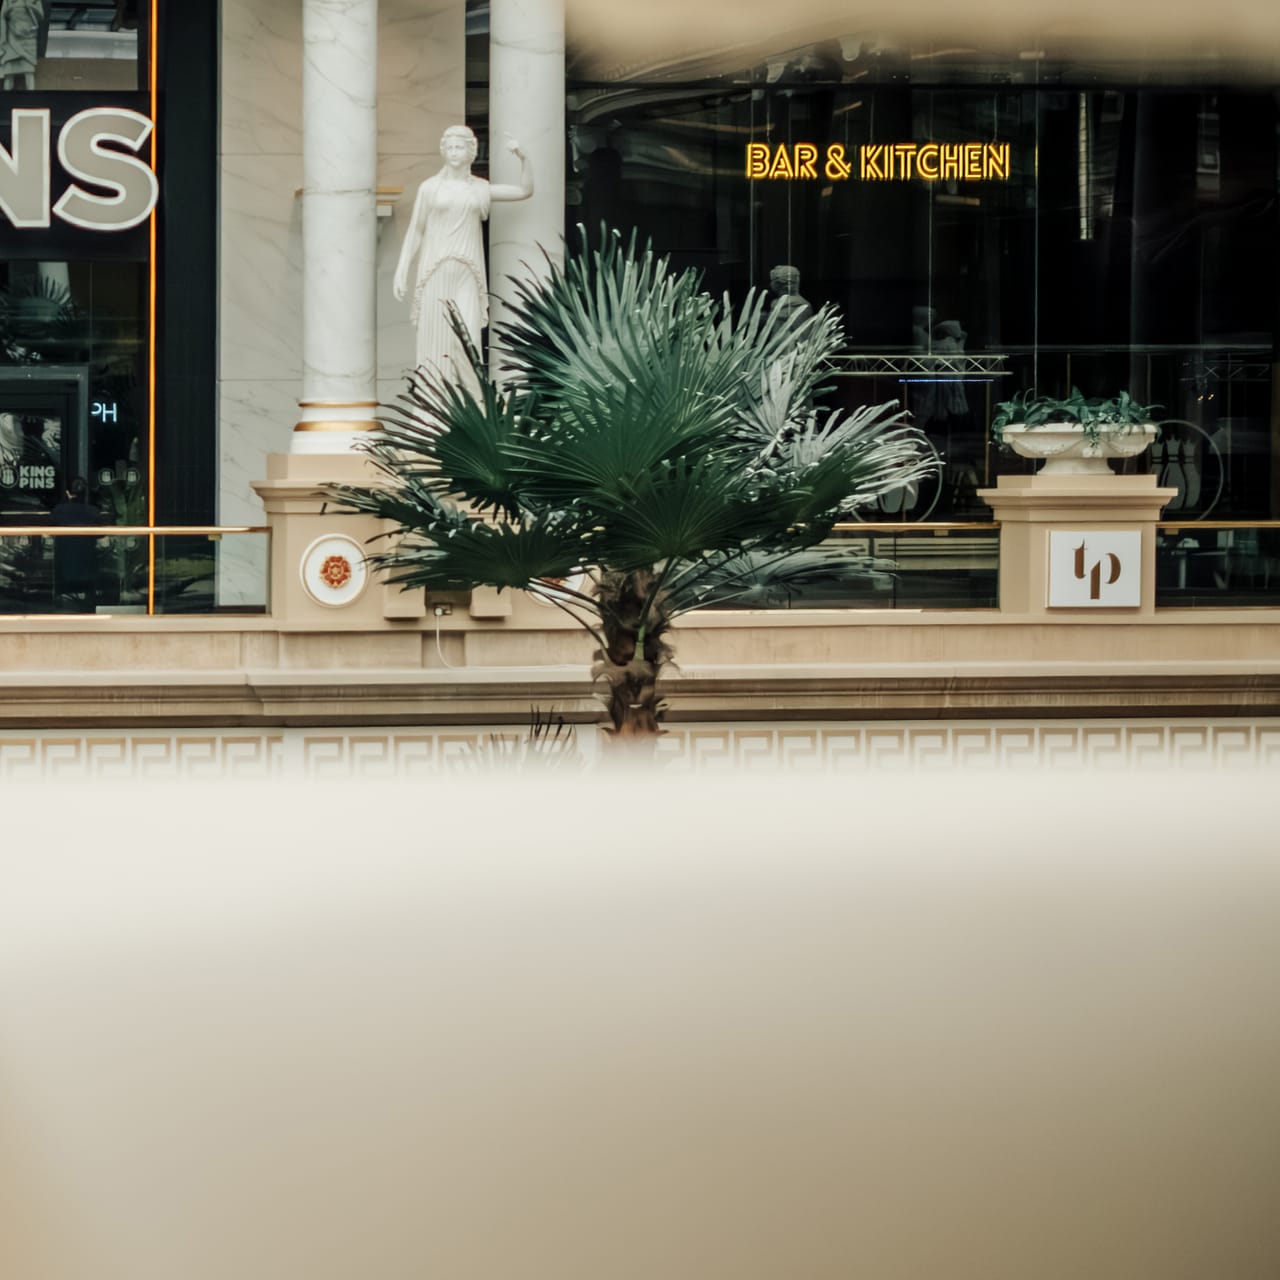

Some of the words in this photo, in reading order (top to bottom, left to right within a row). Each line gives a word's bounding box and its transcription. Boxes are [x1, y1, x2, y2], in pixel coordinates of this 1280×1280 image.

[746, 143, 817, 179] BAR
[825, 144, 851, 179] &
[860, 144, 1010, 180] KITCHEN
[19, 466, 55, 477] KING
[19, 478, 55, 489] PINS
